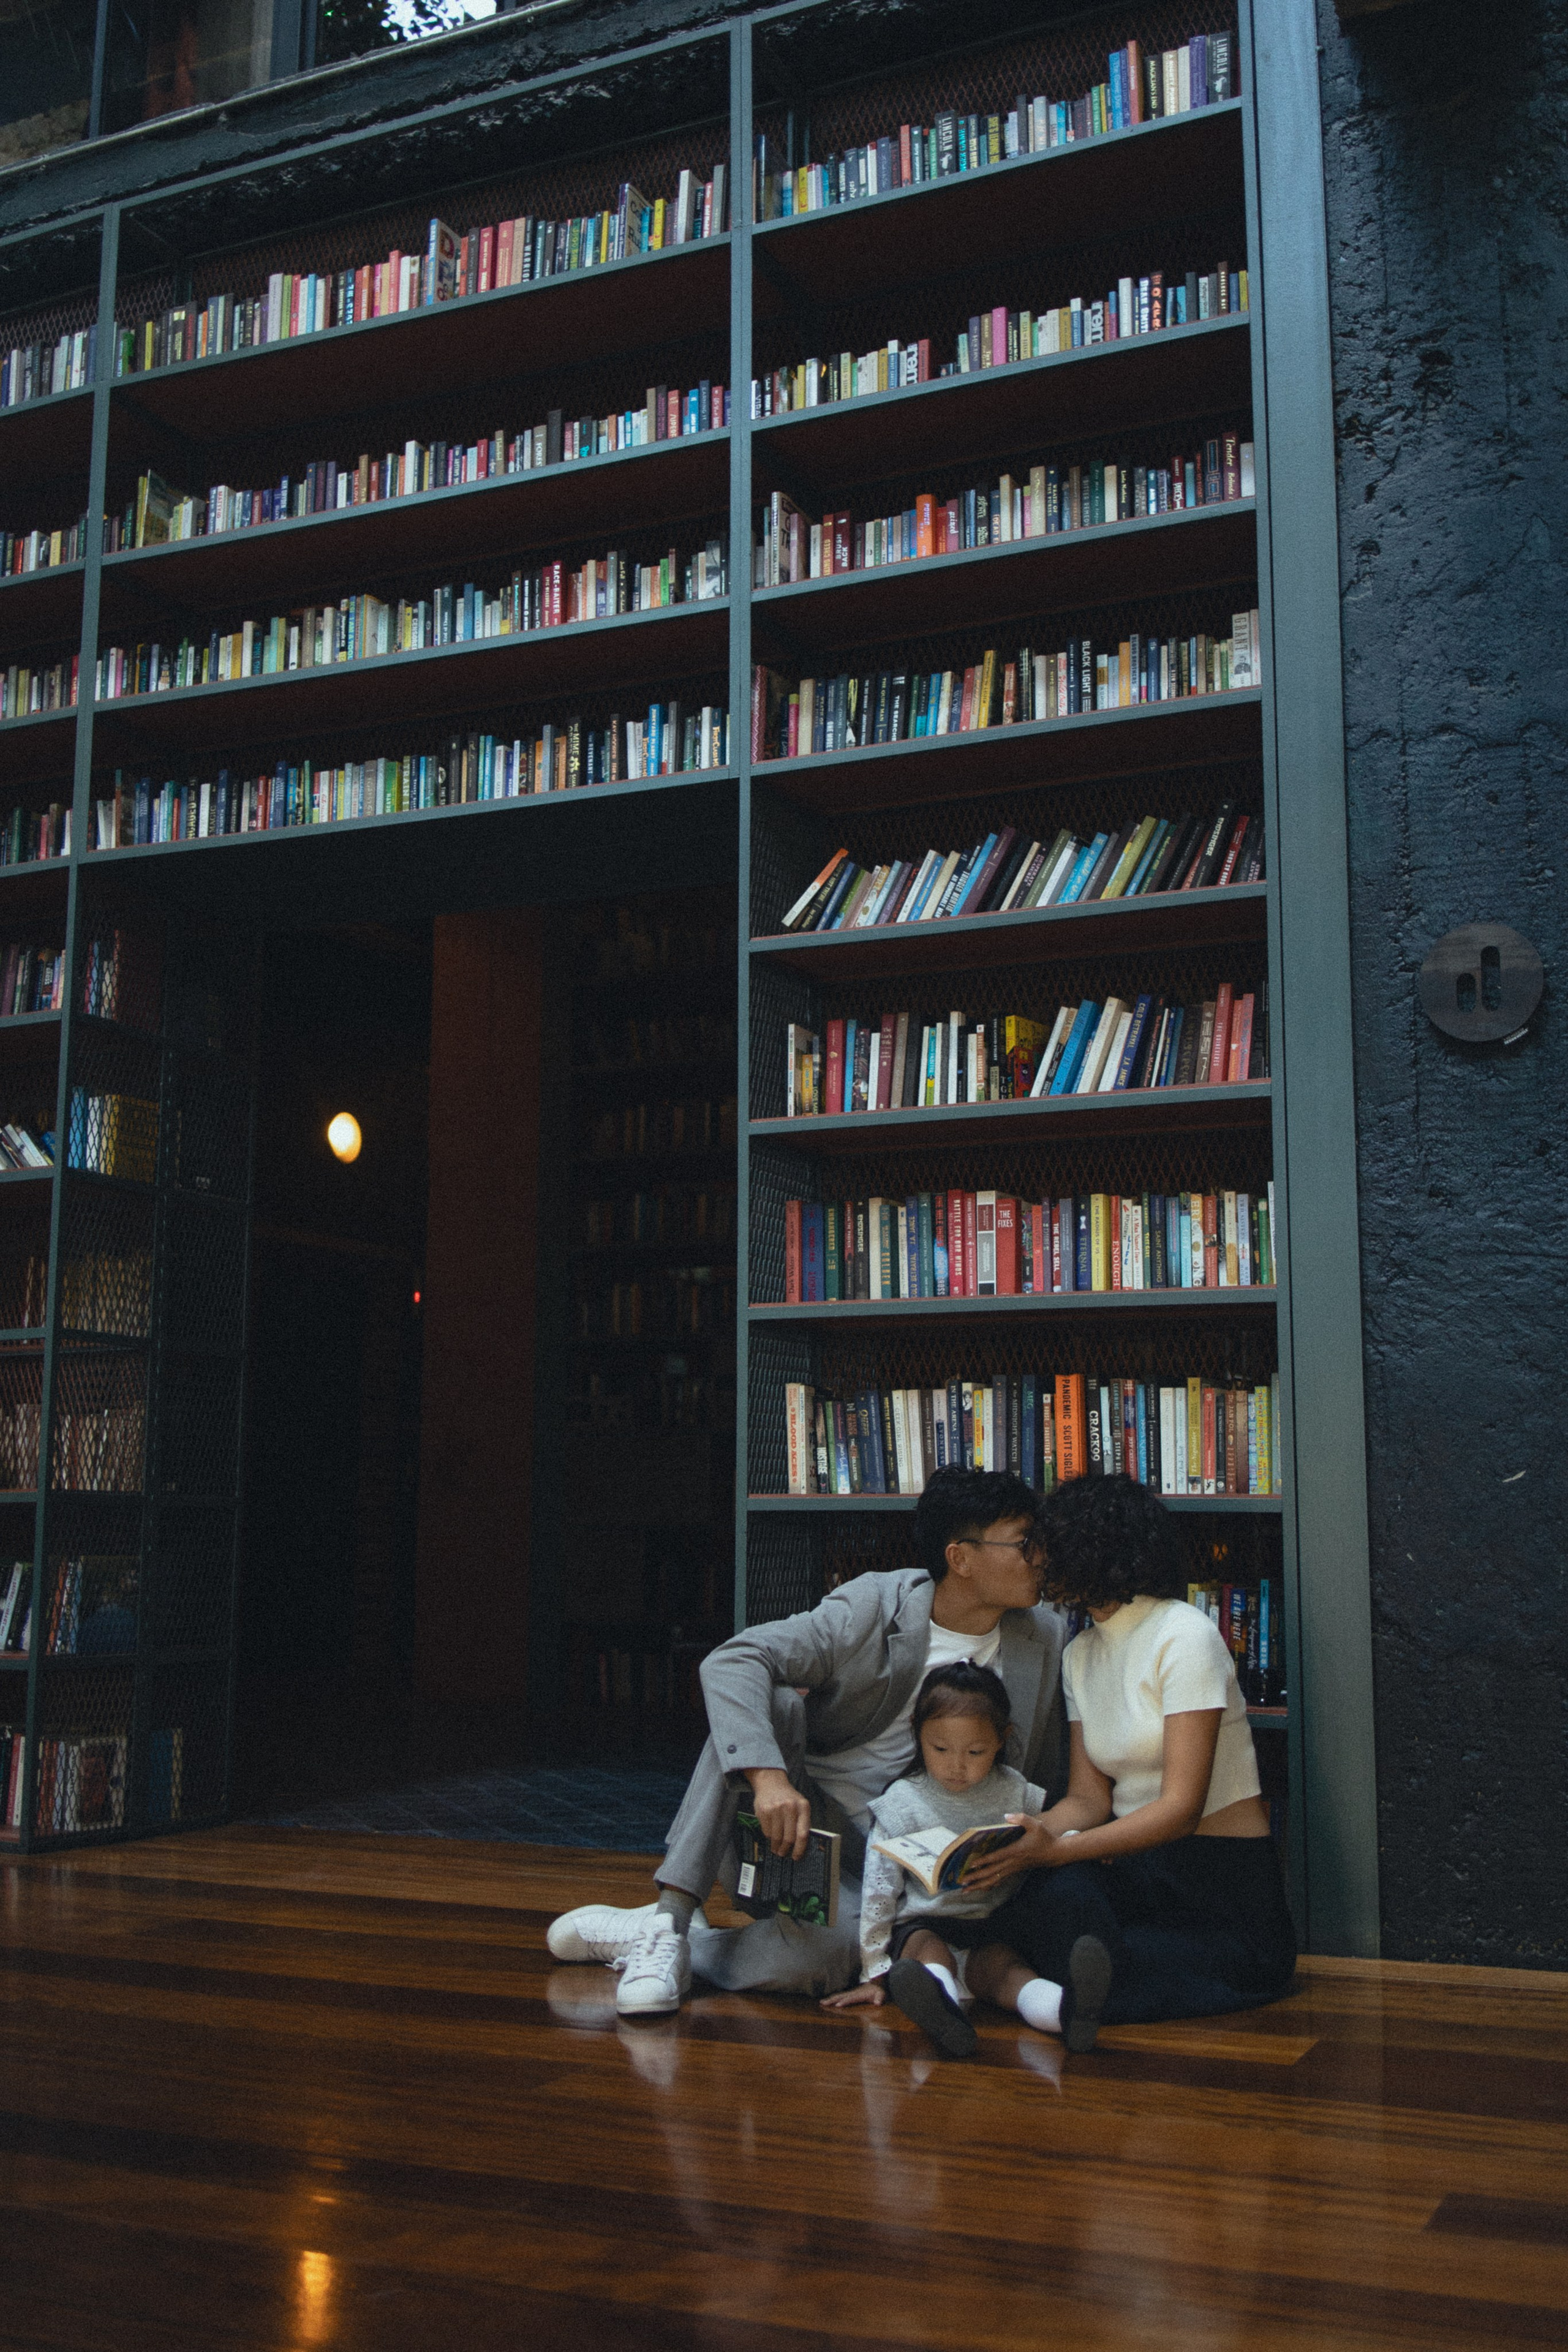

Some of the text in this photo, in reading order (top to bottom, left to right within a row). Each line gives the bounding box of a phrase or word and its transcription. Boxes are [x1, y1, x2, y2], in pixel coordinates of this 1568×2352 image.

[1216, 38, 1228, 74] LINCOLN
[941, 118, 953, 151] LINCOLN
[523, 245, 532, 282] WARRIO
[536, 442, 545, 466] FORES
[1226, 437, 1236, 466] Tender
[1234, 617, 1248, 651] GRANT
[1082, 640, 1091, 693] BLACK LIGHT
[1136, 1003, 1146, 1018] COLD
[1127, 1019, 1141, 1048] BETRAYAL
[1117, 1069, 1128, 1087] JANCE
[953, 1199, 962, 1223] BATTLE
[998, 1219, 1013, 1228] FIXES
[999, 1210, 1011, 1219] THE
[1112, 1240, 1121, 1287] ENOUGH
[1062, 1379, 1071, 1420] PANDEMIC
[1063, 1425, 1072, 1450] SCOTT
[1088, 1410, 1100, 1462] CRACK99
[1233, 1593, 1242, 1641] WE ARE HERE
